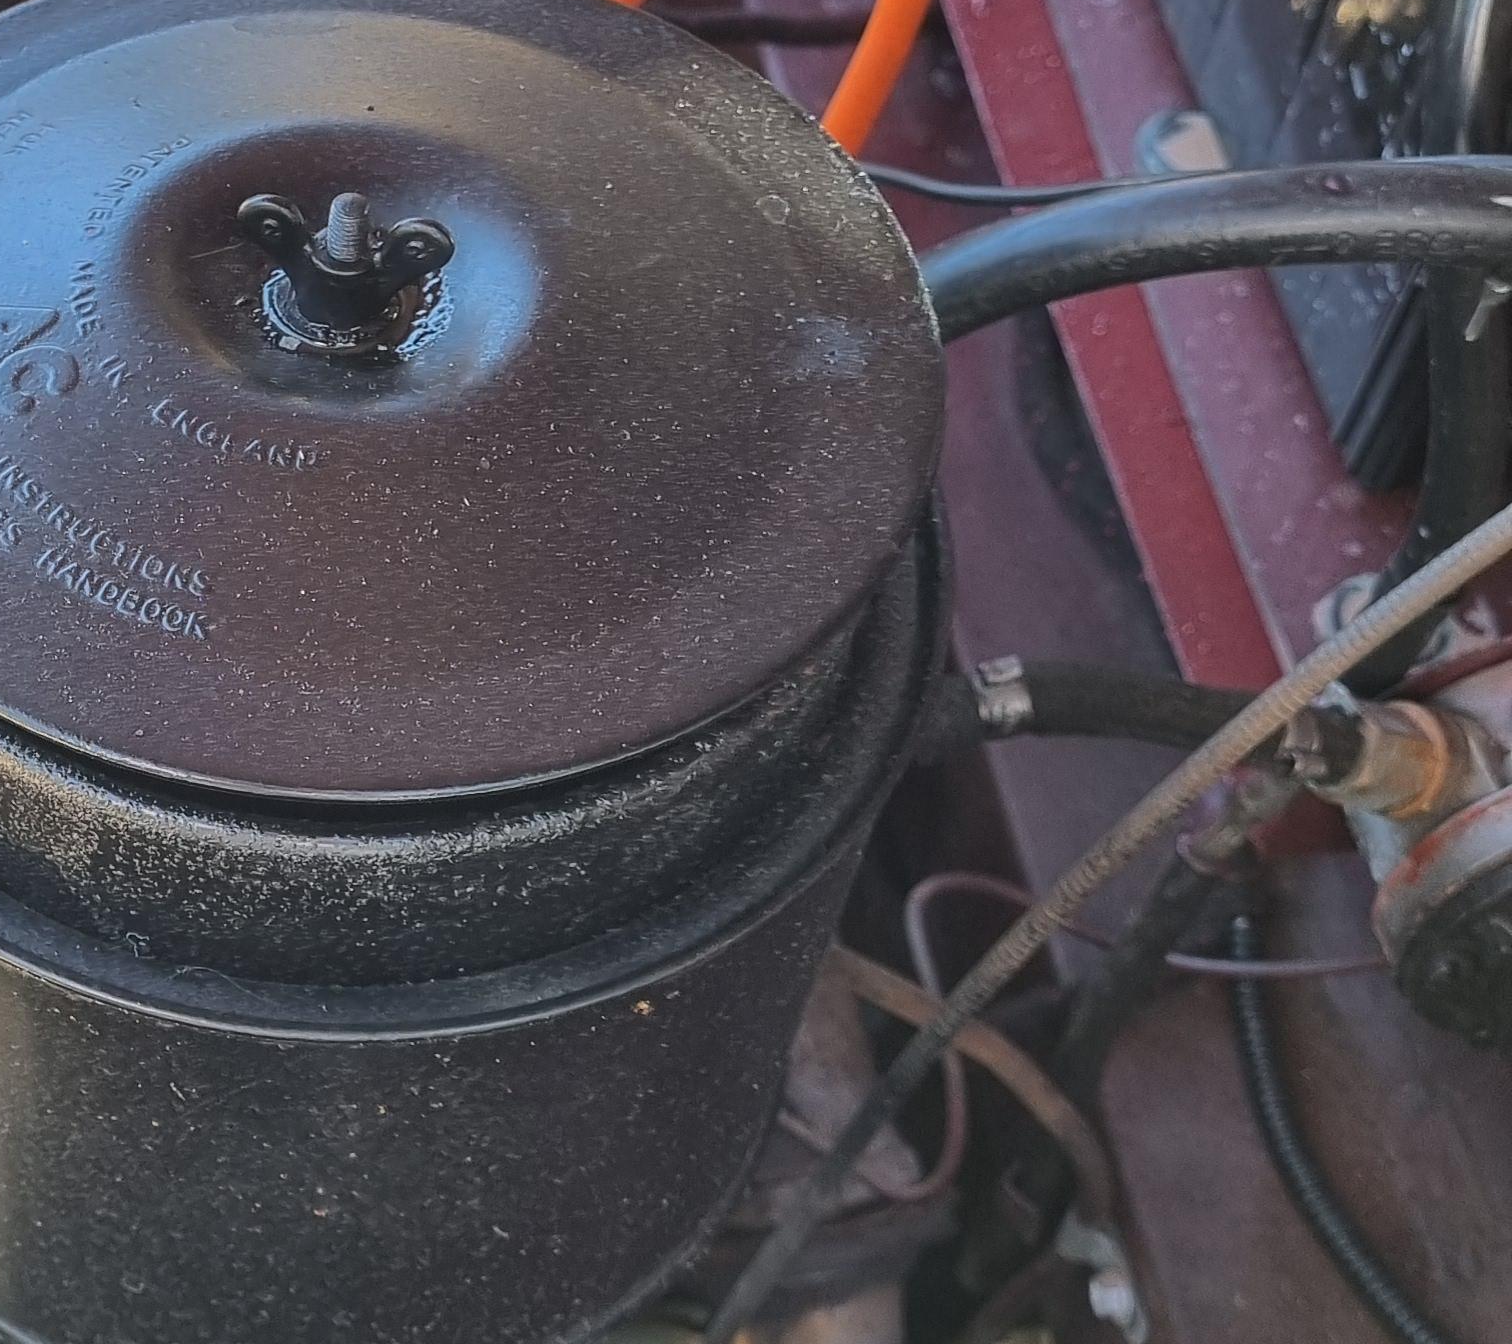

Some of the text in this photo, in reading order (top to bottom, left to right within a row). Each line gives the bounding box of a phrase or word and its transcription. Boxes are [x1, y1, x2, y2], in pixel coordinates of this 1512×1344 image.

[81, 136, 194, 239] PATENTED
[66, 259, 104, 338] MADE
[150, 398, 318, 472] ENGLAND
[35, 548, 207, 640] HANDBOOK
